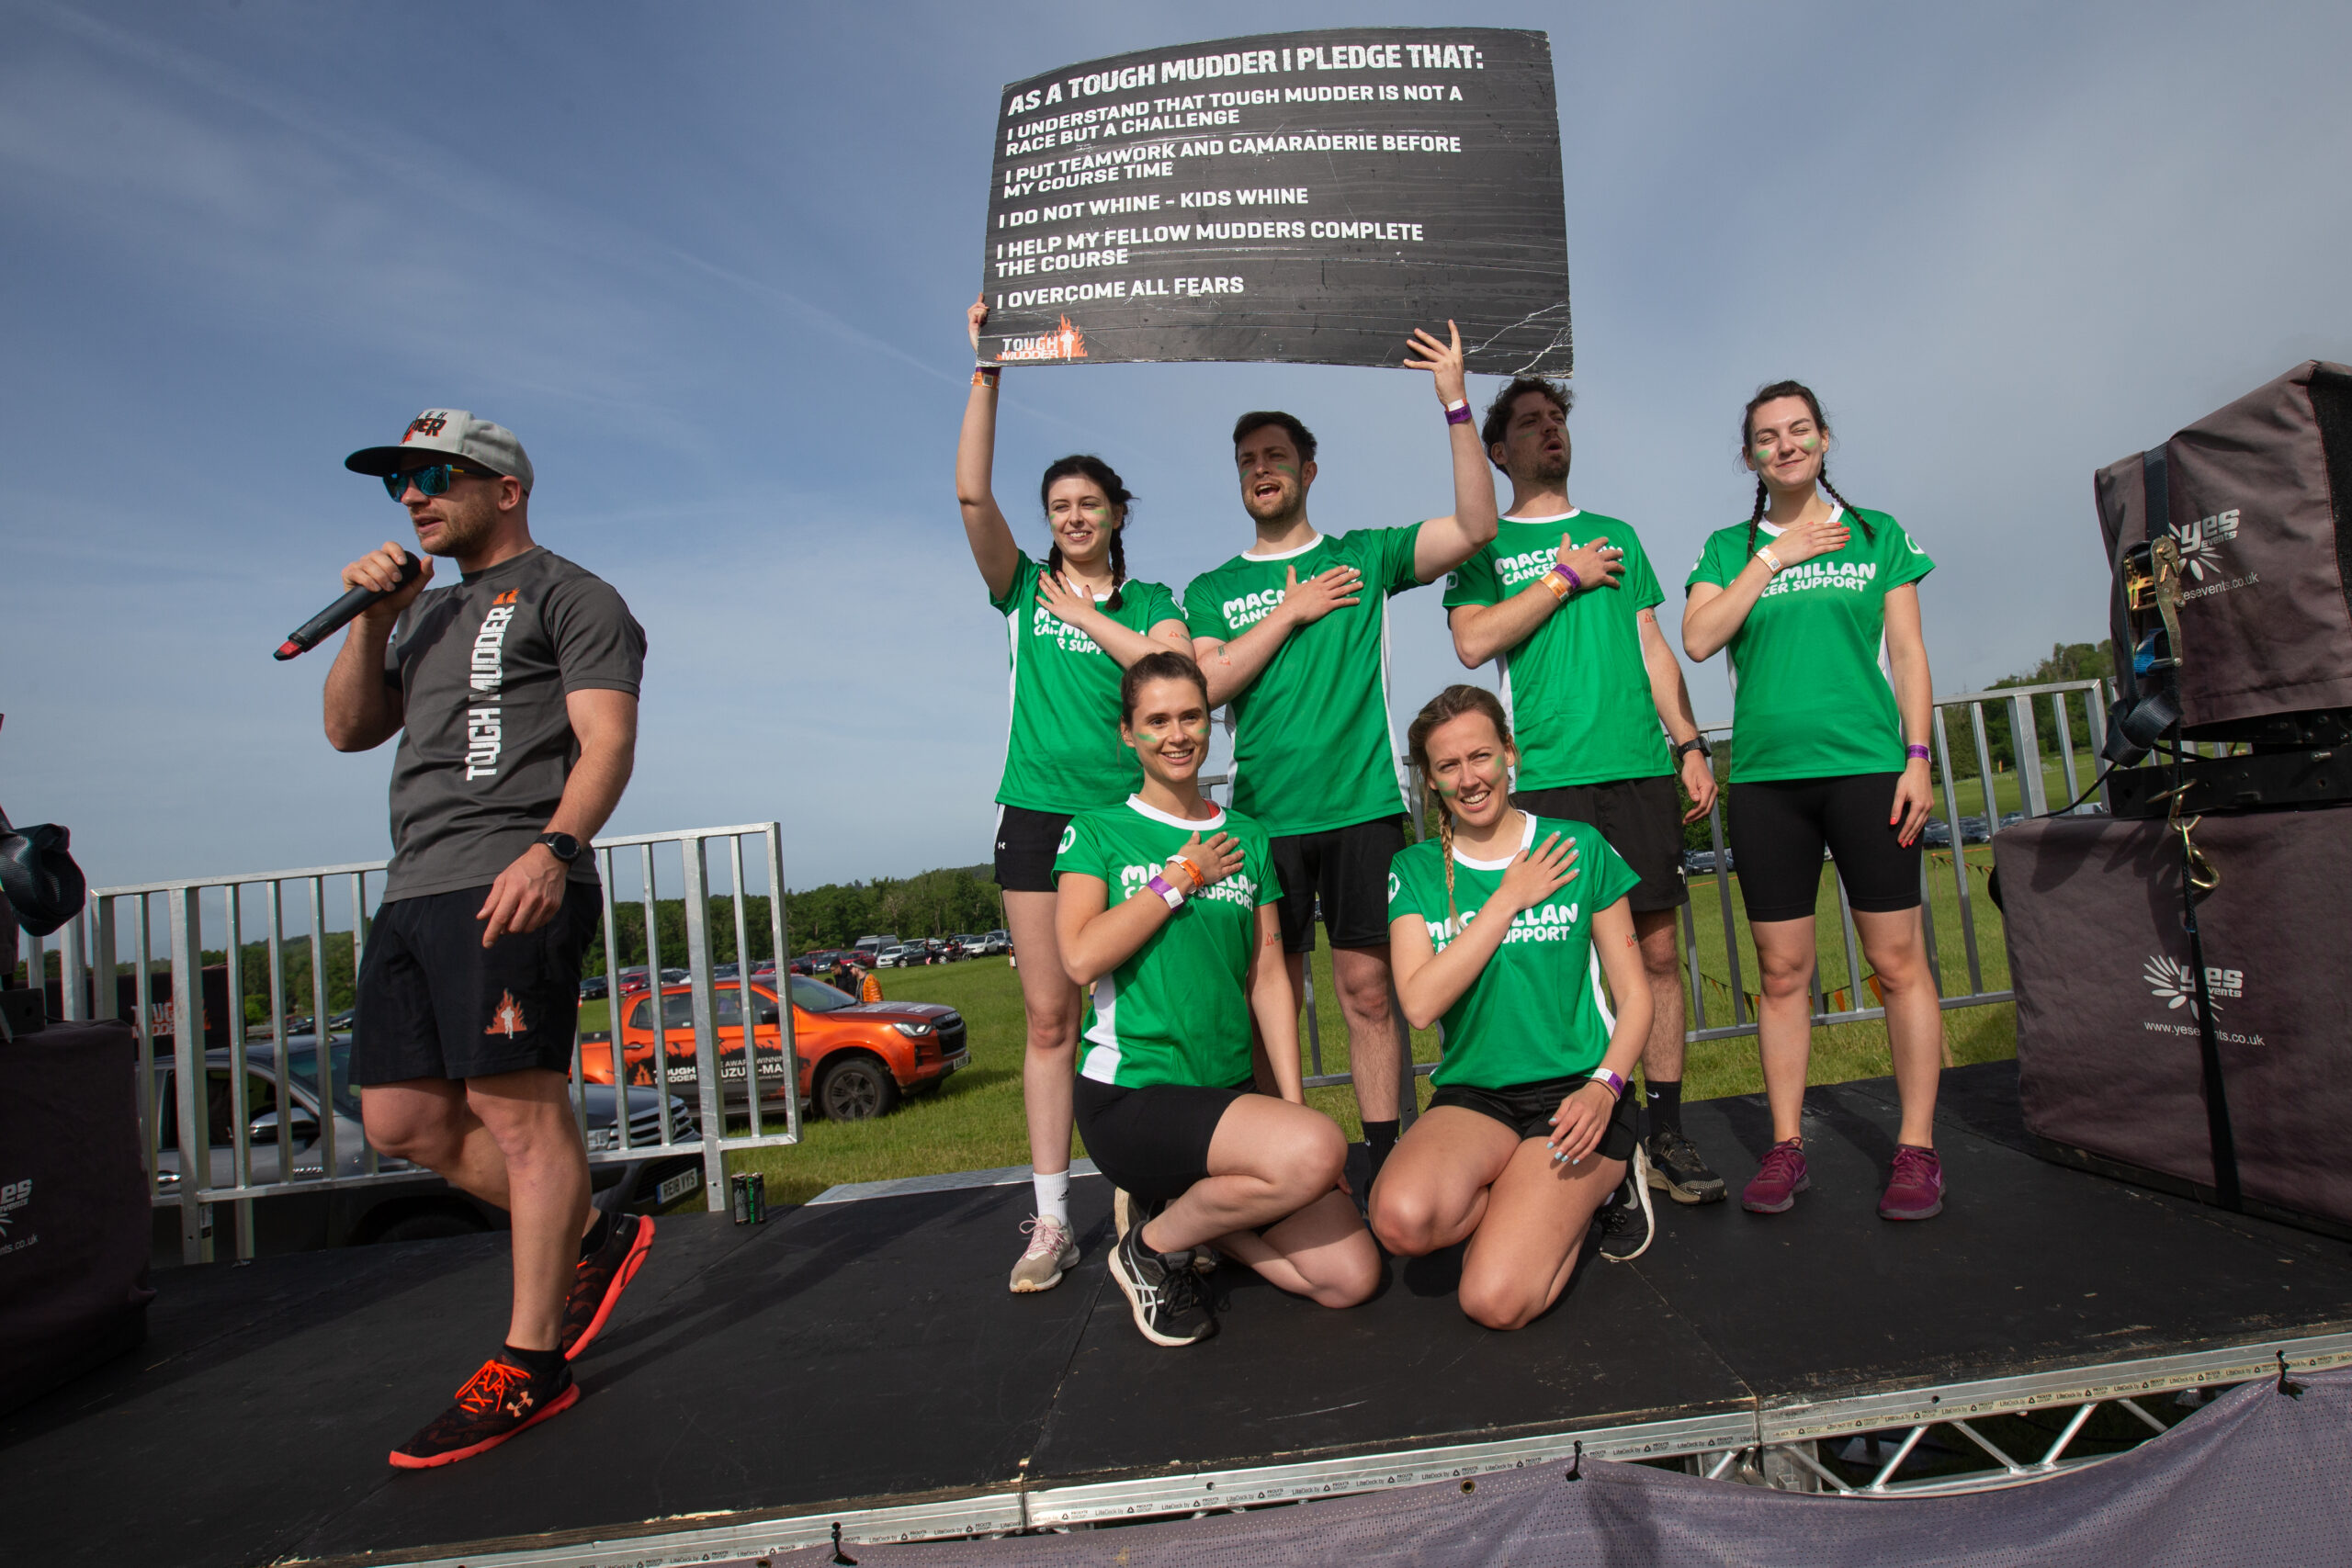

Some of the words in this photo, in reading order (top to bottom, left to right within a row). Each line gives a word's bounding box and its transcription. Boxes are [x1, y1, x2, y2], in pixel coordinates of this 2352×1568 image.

[1008, 89, 1041, 117] AS
[1046, 83, 1062, 106] A
[1068, 63, 1155, 99] TOUGH
[1161, 49, 1277, 84] MUDDER
[1283, 49, 1292, 72] I
[1296, 44, 1402, 71] PLEDGE
[1406, 44, 1484, 70] THAT:
[1007, 128, 1012, 141] I
[1018, 101, 1149, 139] UNDERSTAND
[1153, 94, 1205, 113] THAT
[1209, 88, 1280, 107] TOUGH
[1284, 85, 1374, 103] MUDDER
[1379, 85, 1399, 101] IS
[1404, 85, 1444, 101] NOT
[1449, 85, 1463, 101] A
[1006, 137, 1056, 156] RACE
[1060, 125, 1100, 146] BUT
[1103, 123, 1117, 138] A
[1121, 109, 1240, 135] CHALLENGE
[1005, 170, 1012, 184] I
[1016, 162, 1056, 182] PUT
[1058, 143, 1176, 174] TEAMWORK
[1180, 139, 1224, 158] AND
[1229, 135, 1378, 154] CAMARADERIE
[1383, 136, 1461, 152] BEFORE
[1003, 181, 1035, 199] MY
[1037, 165, 1119, 193] COURSE
[1123, 161, 1174, 179] TIME
[999, 214, 1005, 229] I
[1010, 209, 1038, 227] DO
[1044, 201, 1085, 221] NOT
[1090, 194, 1160, 216] WHINE
[1181, 190, 1231, 209] KIDS
[1236, 187, 1308, 206] WHINE
[997, 244, 1002, 259] I
[1008, 236, 1062, 258] HELP
[1067, 231, 1100, 251] MY
[1104, 225, 1191, 247] FELLOW
[1196, 221, 1306, 240] MUDDERS
[1310, 221, 1423, 242] COMPLETE
[996, 259, 1035, 278] THE
[1040, 248, 1128, 272] COURSE
[997, 294, 1003, 310] I
[1008, 281, 1126, 308] OVERCOME
[1130, 279, 1169, 297] ALL
[1174, 276, 1244, 295] FEARS
[1001, 349, 1059, 361] MUDDER
[1002, 336, 1058, 353] TOUGH
[2180, 509, 2240, 555] yes
[2200, 531, 2239, 547] events
[1760, 582, 1789, 597] CER
[1792, 576, 1867, 592] SUPPORT
[2182, 571, 2260, 601] esevents.co.uk
[1229, 606, 1277, 629] CANC
[468, 605, 514, 701] MUDDER
[465, 707, 502, 781] TOUGH
[2208, 987, 2243, 998] vents
[721, 1066, 746, 1077] UZU
[0, 1179, 32, 1205] es
